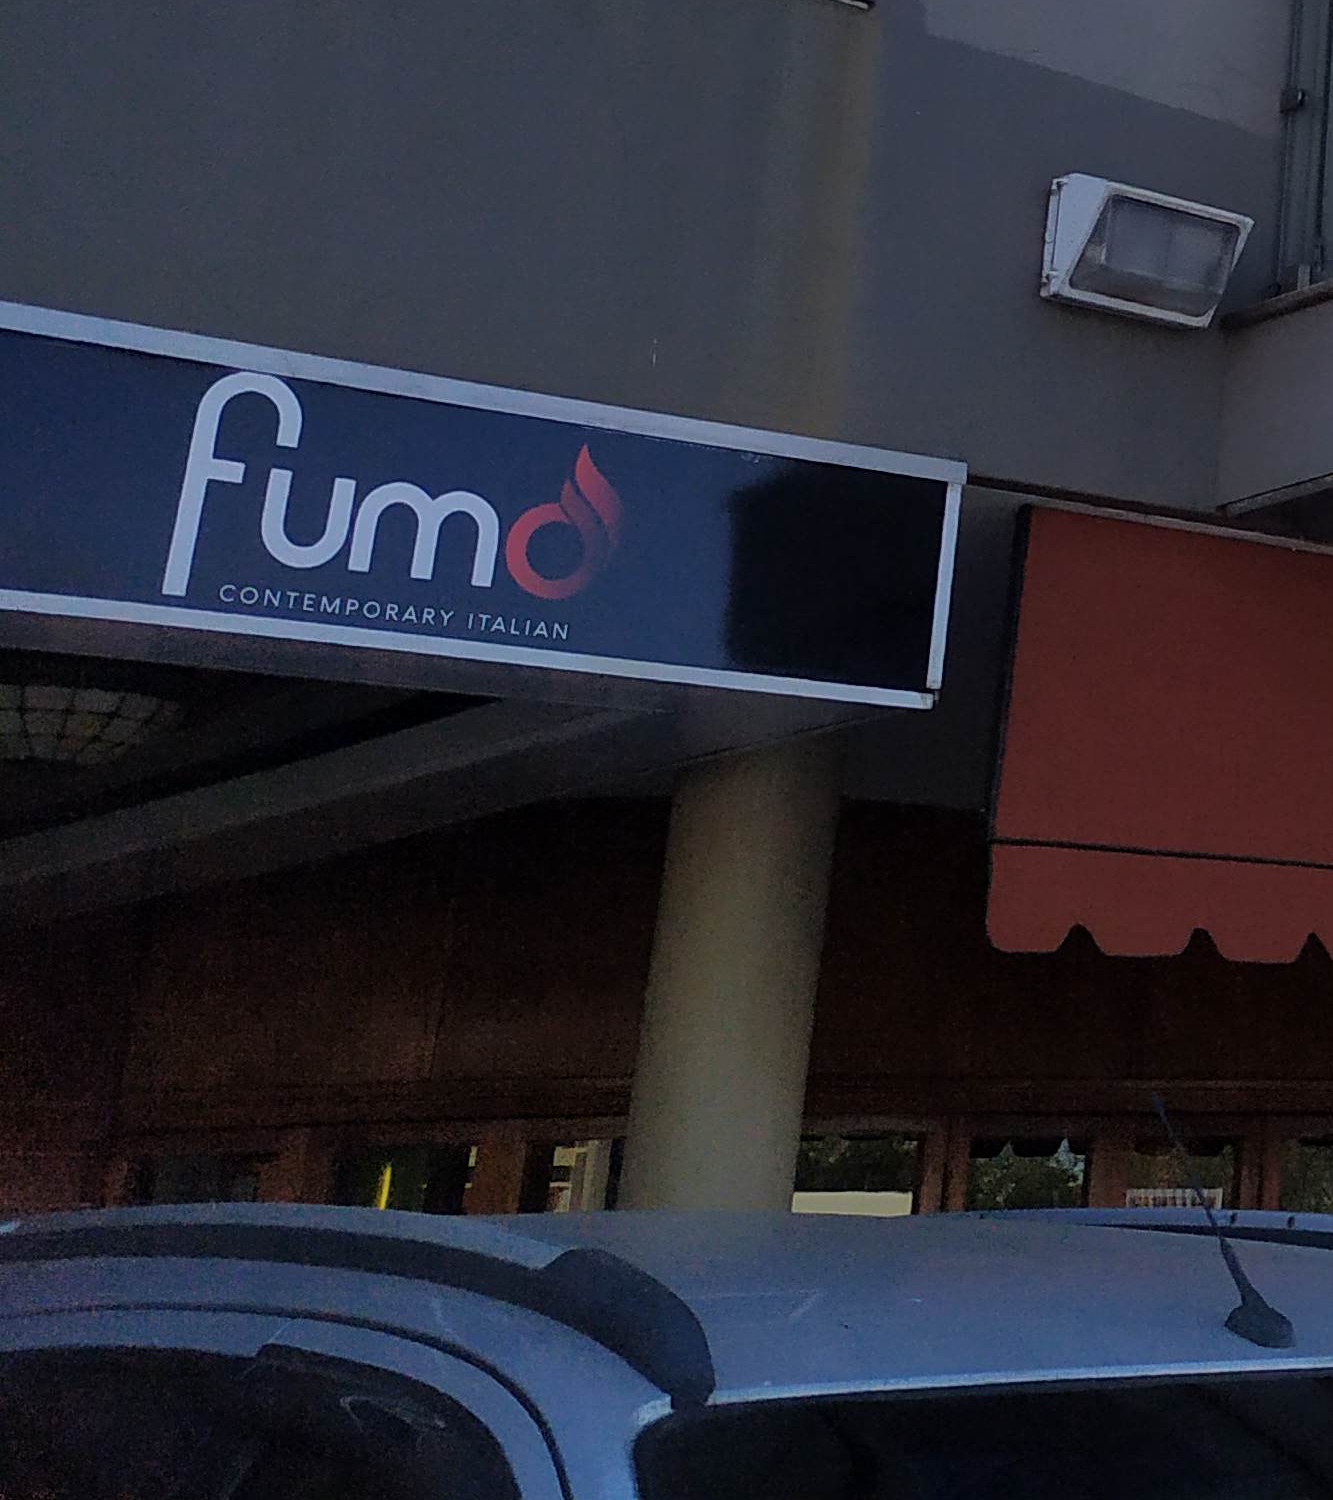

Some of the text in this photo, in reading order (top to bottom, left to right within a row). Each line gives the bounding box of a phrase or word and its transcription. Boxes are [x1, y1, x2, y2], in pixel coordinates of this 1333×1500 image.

[161, 370, 622, 600] fumo
[219, 583, 570, 641] CONTEMPORARY ITALIAN
